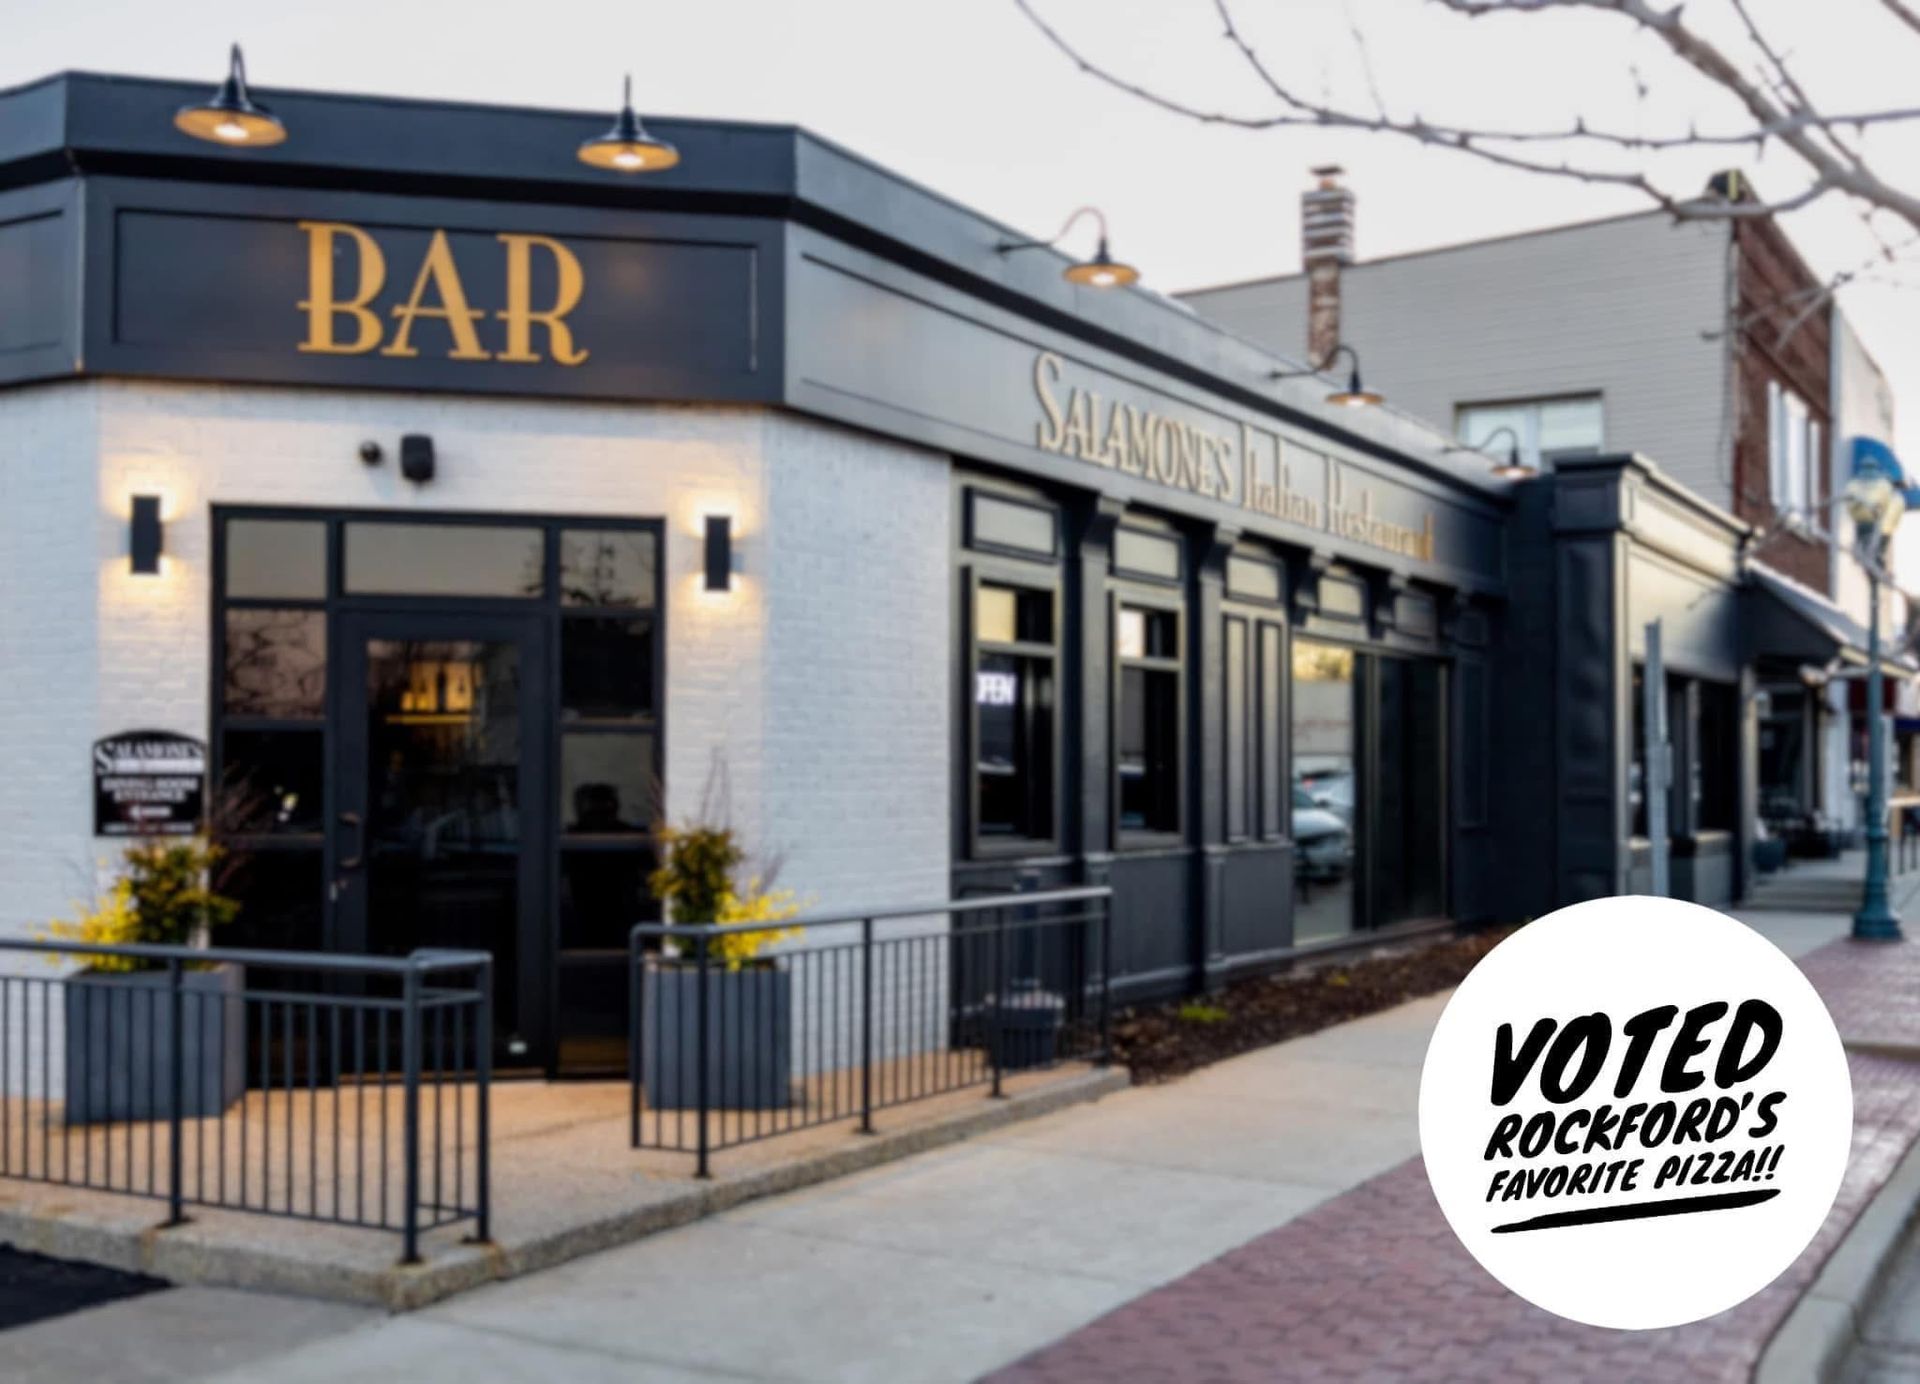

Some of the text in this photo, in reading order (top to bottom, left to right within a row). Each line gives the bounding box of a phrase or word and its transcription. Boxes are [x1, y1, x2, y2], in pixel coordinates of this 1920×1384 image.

[297, 221, 589, 366] BAR
[1243, 422, 1320, 529] Italian
[1327, 456, 1435, 562] Restaurant
[977, 672, 1016, 704] PEN
